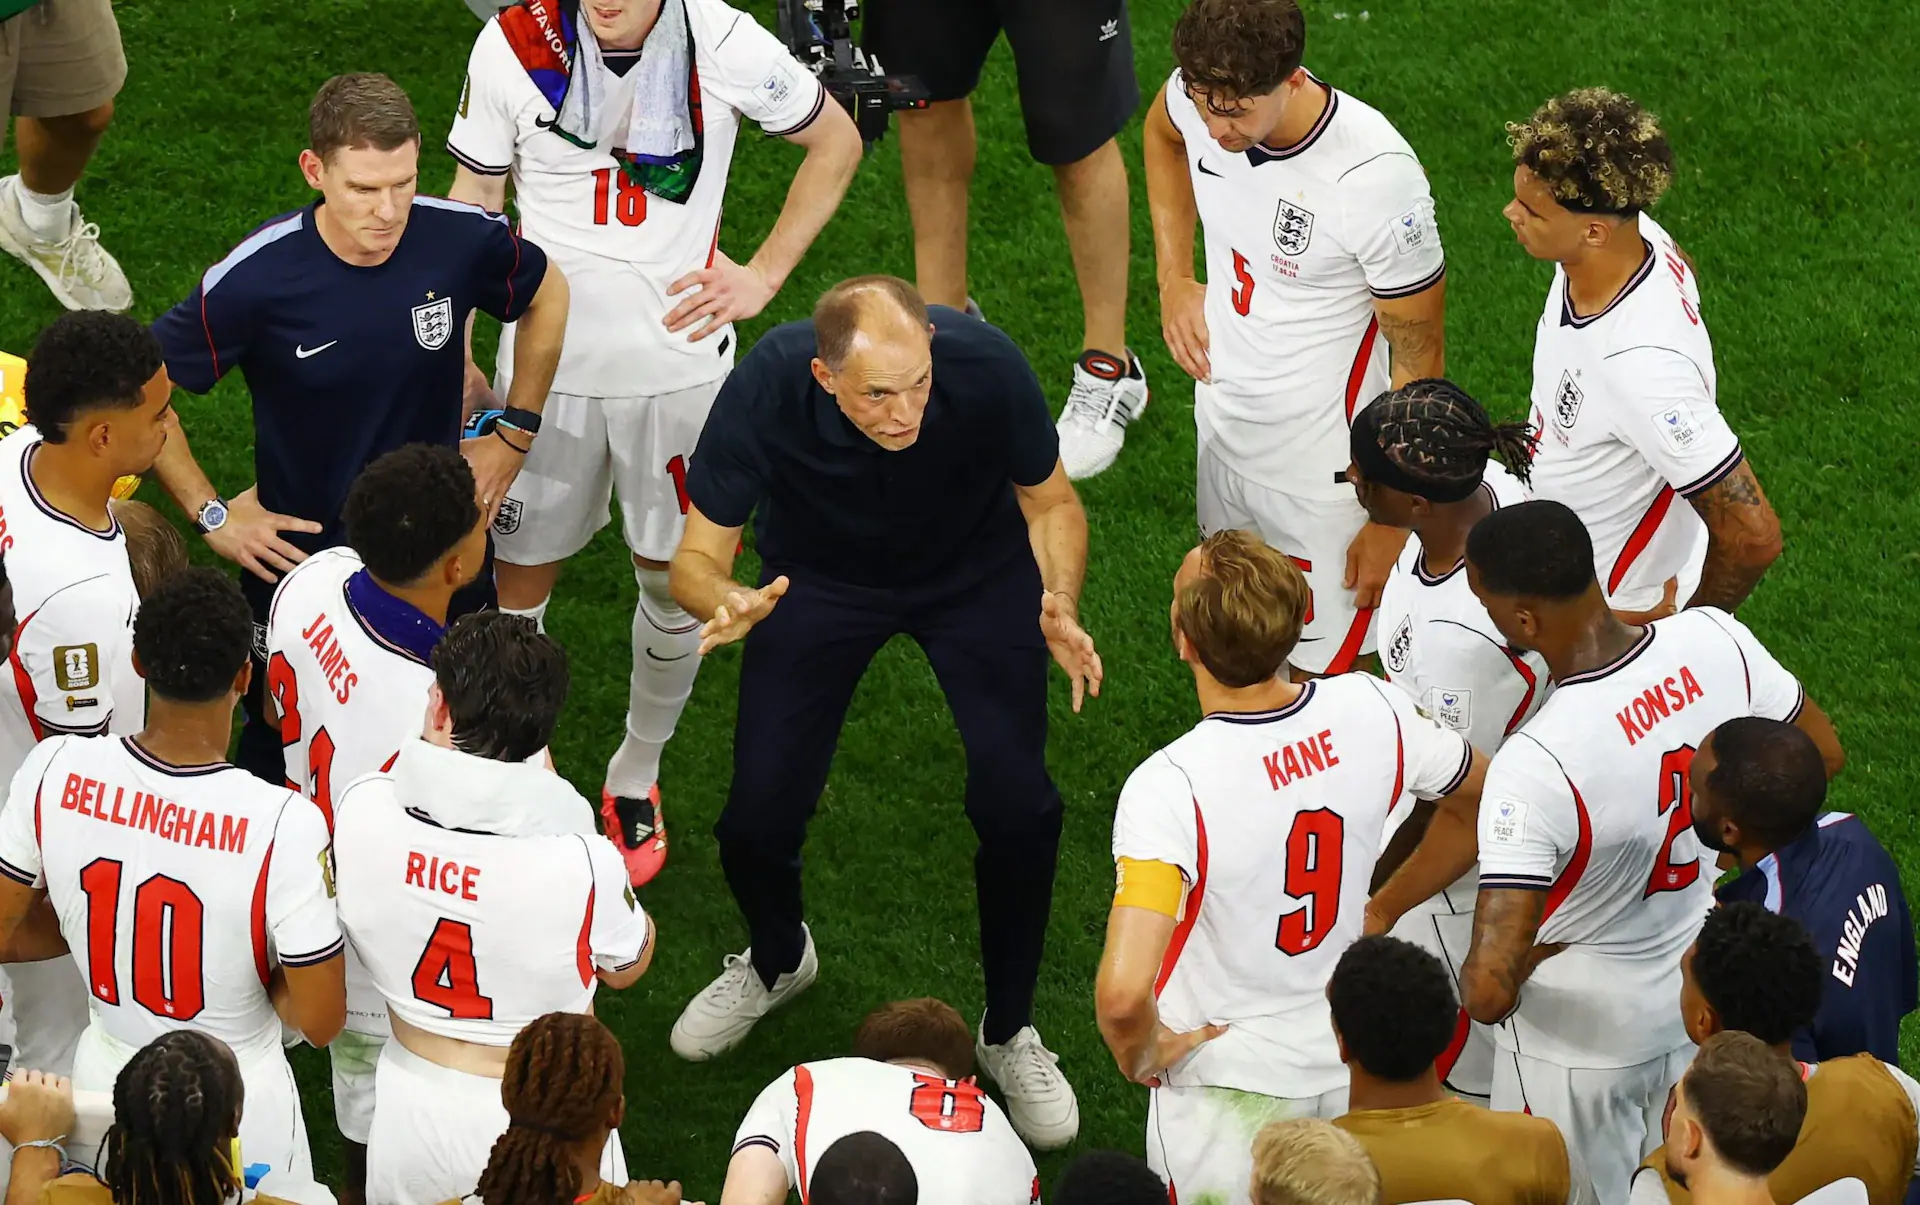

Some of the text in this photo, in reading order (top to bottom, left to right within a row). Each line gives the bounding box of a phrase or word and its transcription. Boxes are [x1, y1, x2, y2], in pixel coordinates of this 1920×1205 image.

[591, 168, 647, 226] 18
[1231, 247, 1255, 317] 5
[1270, 254, 1300, 271] CROATIA
[302, 613, 358, 705] JAMES
[1616, 665, 1704, 746] KONSA
[1263, 729, 1340, 791] KANE
[60, 772, 249, 854] BELLINGHAM
[1494, 826, 1514, 837] PEACE
[1642, 743, 1700, 901] 2
[405, 851, 481, 901] RICE
[1275, 806, 1344, 957] 9
[80, 857, 205, 1021] 10
[411, 917, 493, 1020] 4
[1832, 883, 1888, 988] ENGLAND
